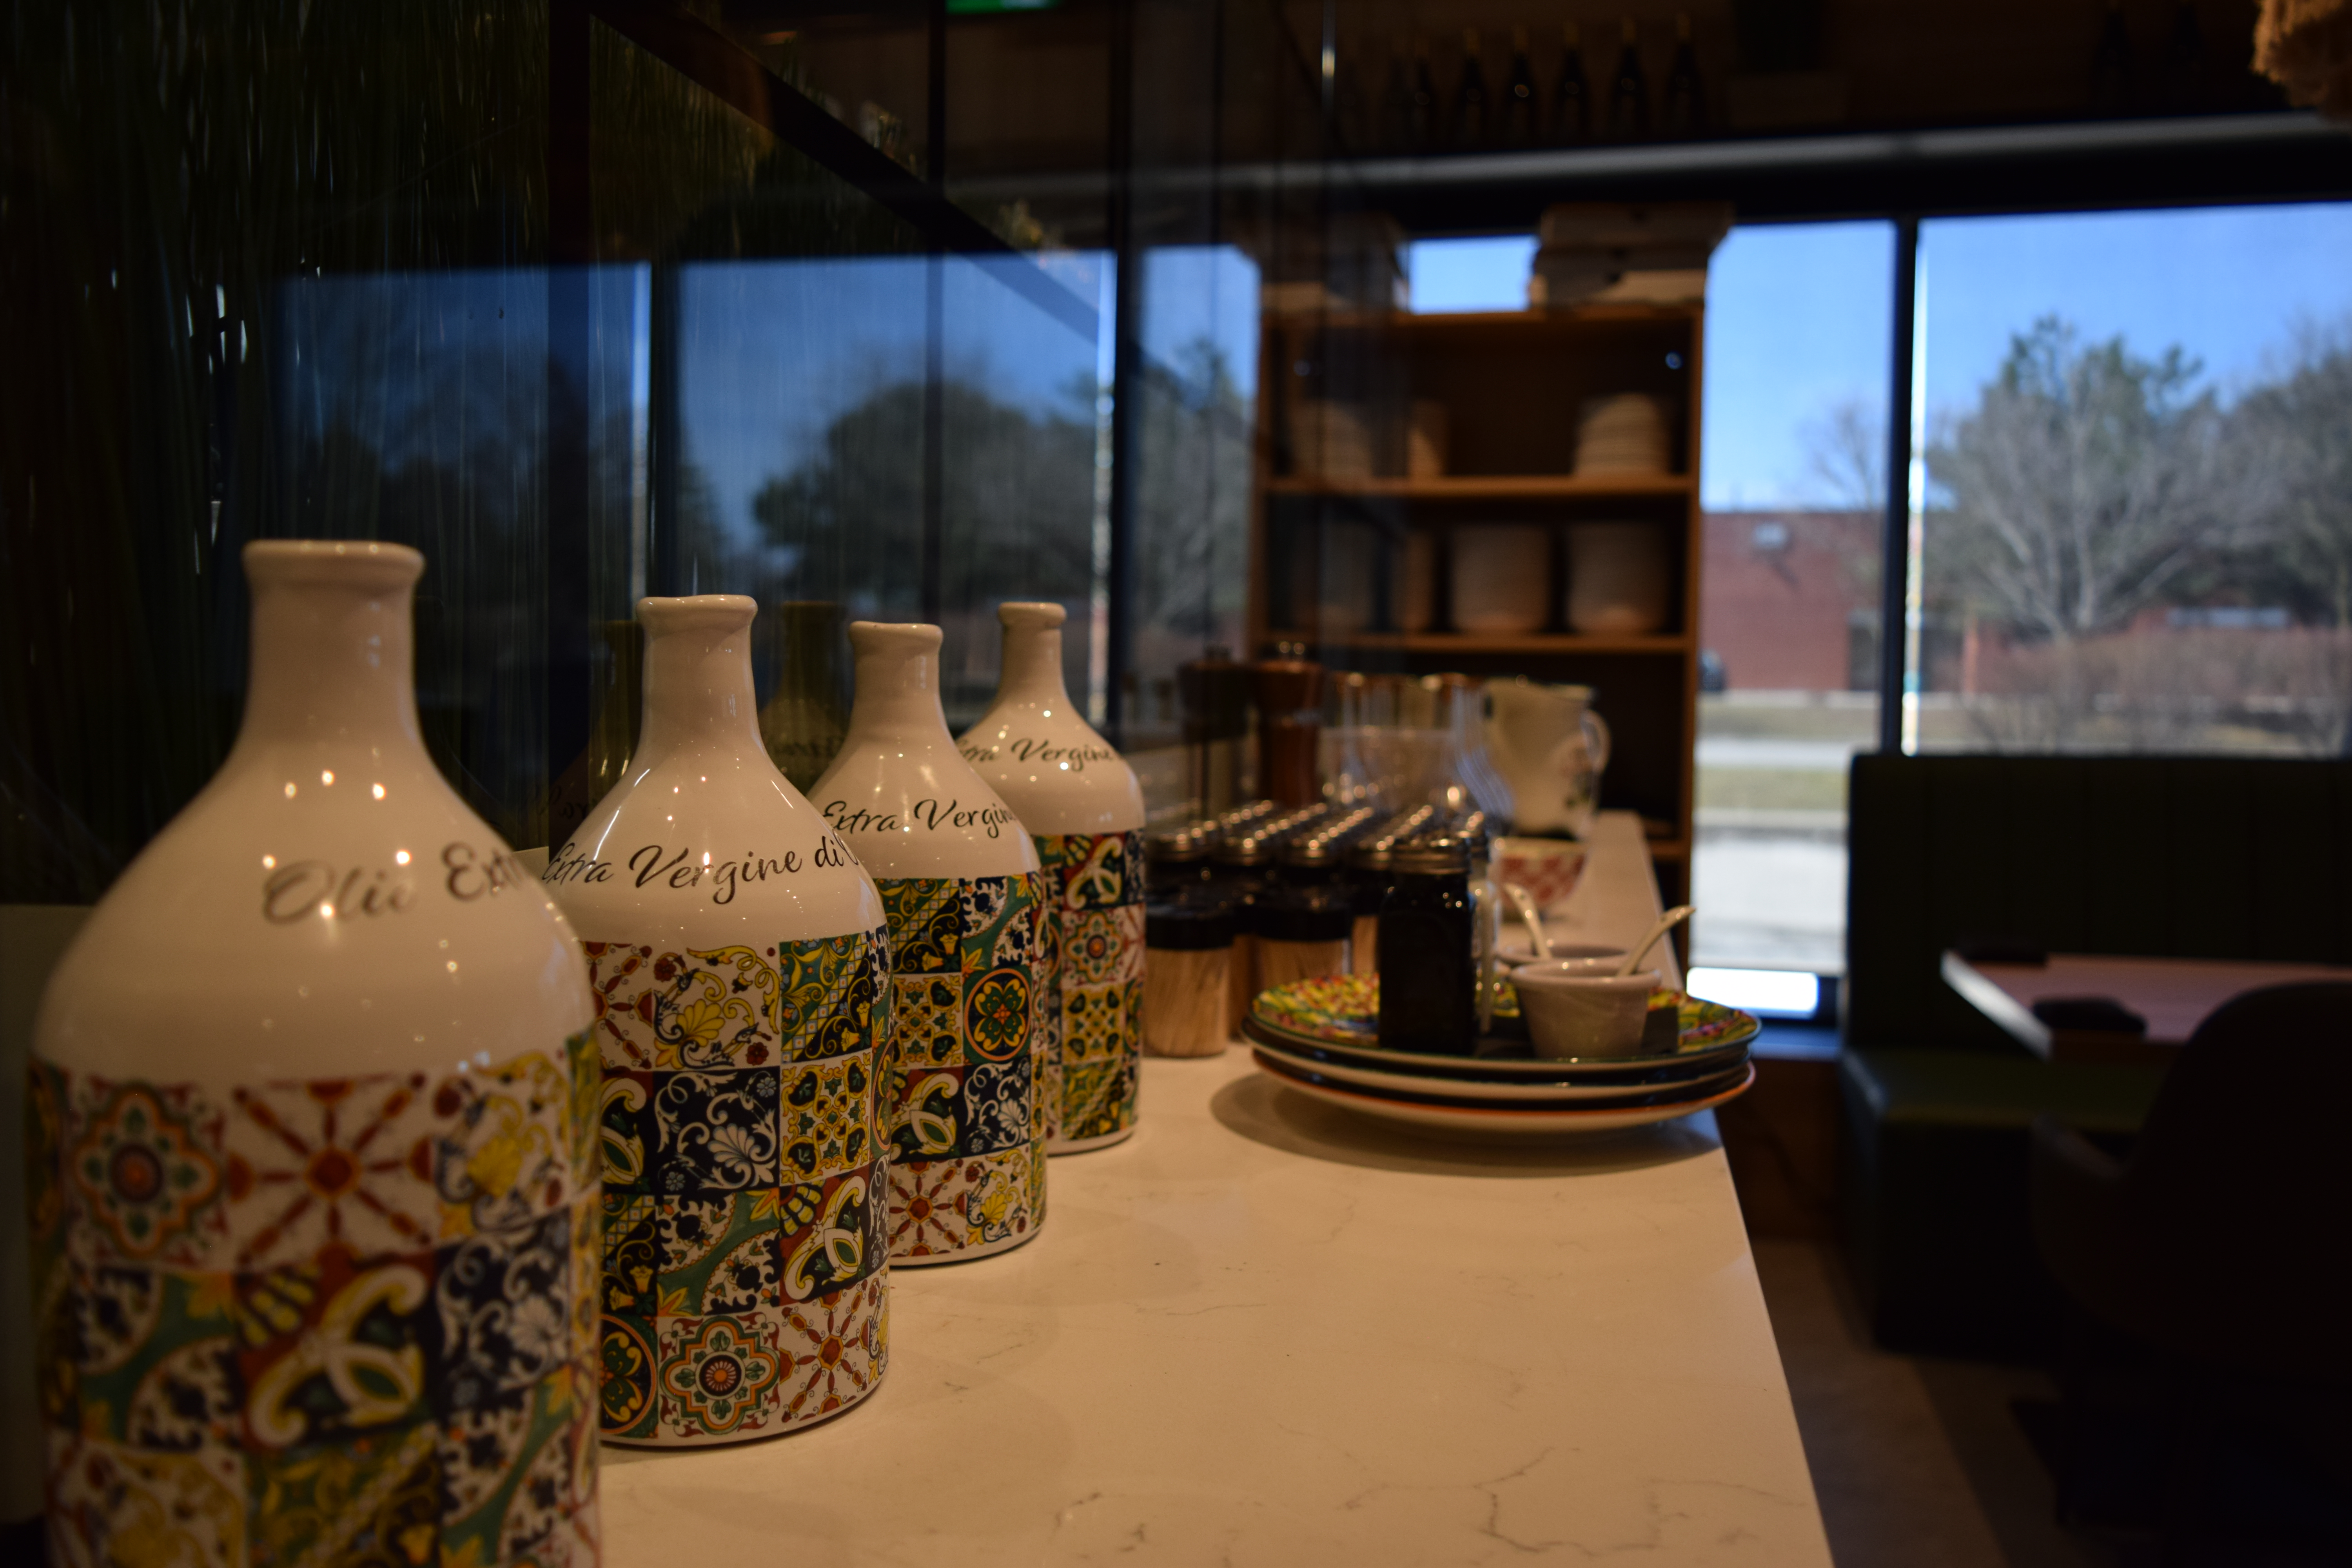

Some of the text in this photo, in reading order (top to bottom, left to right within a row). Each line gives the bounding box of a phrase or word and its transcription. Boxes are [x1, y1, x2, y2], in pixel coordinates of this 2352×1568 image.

[823, 800, 903, 835] Extra
[263, 860, 417, 925] Olio
[542, 842, 614, 885] Extra
[629, 845, 803, 905] Vergine
[815, 835, 844, 868] di
